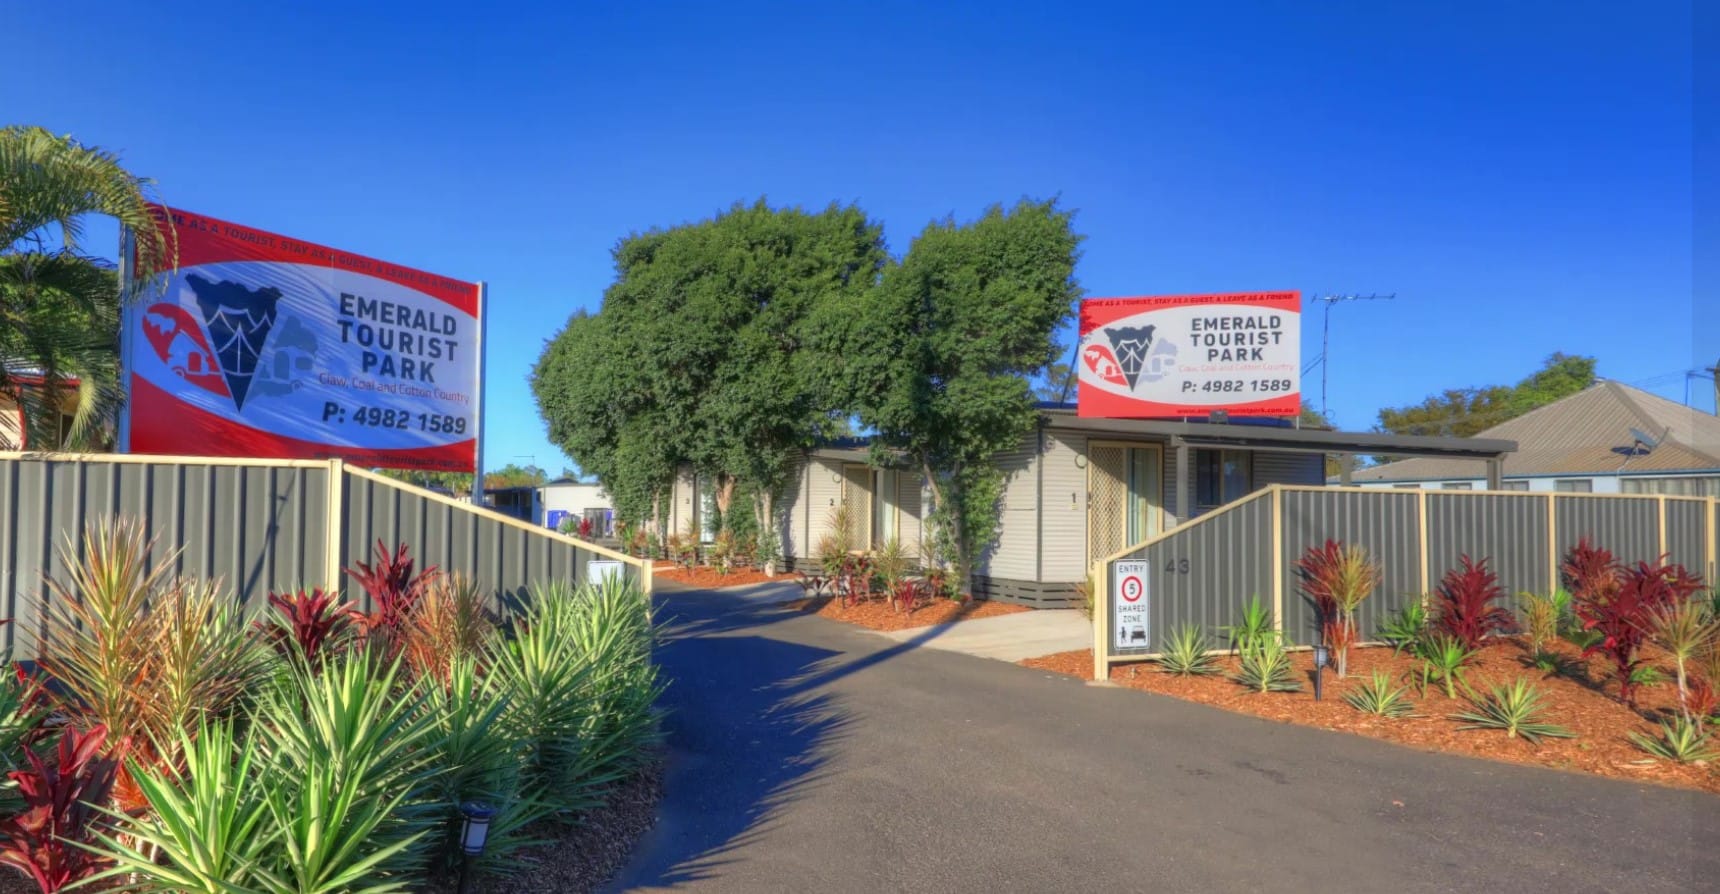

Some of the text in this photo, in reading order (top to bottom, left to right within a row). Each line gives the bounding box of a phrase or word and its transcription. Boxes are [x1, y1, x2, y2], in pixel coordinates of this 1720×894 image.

[190, 217, 207, 232] AS
[210, 223, 219, 234] A
[280, 240, 308, 255] STAY
[311, 249, 325, 259] AS
[339, 292, 457, 336] EMERALD
[1191, 315, 1282, 332] EMERALD
[337, 319, 458, 361] TOURIST
[1190, 331, 1283, 347] TOURIST
[1207, 347, 1264, 362] PARK
[362, 351, 435, 383] PARK
[319, 372, 470, 406] Claw, Coal and Cotton Country
[1181, 379, 1292, 393] P: 4982 1589
[322, 401, 466, 435] P: 4982 1589
[1118, 564, 1145, 573] ENTRY
[1165, 558, 1190, 575] 43
[1128, 583, 1136, 595] 5
[1118, 604, 1146, 613] SHARED
[1123, 615, 1142, 623] ZONE
